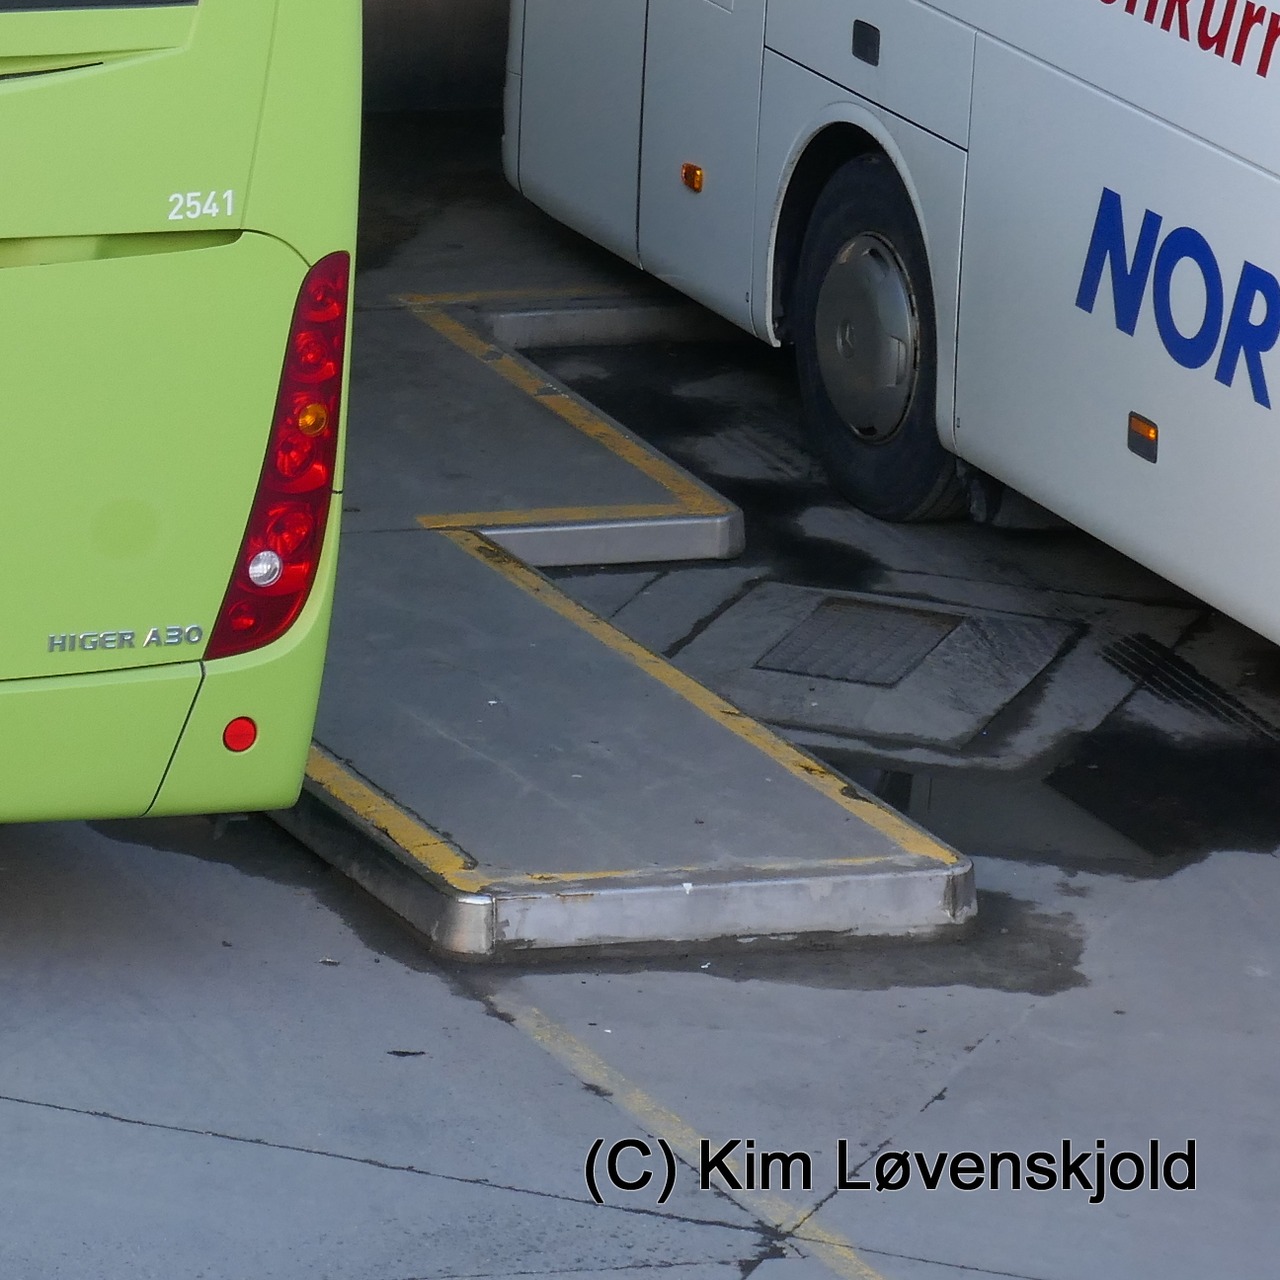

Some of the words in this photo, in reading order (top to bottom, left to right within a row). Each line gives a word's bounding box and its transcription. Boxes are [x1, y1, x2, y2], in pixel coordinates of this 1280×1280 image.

[167, 189, 234, 220] 2541
[47, 629, 136, 653] HIGER
[142, 624, 204, 648] A30
